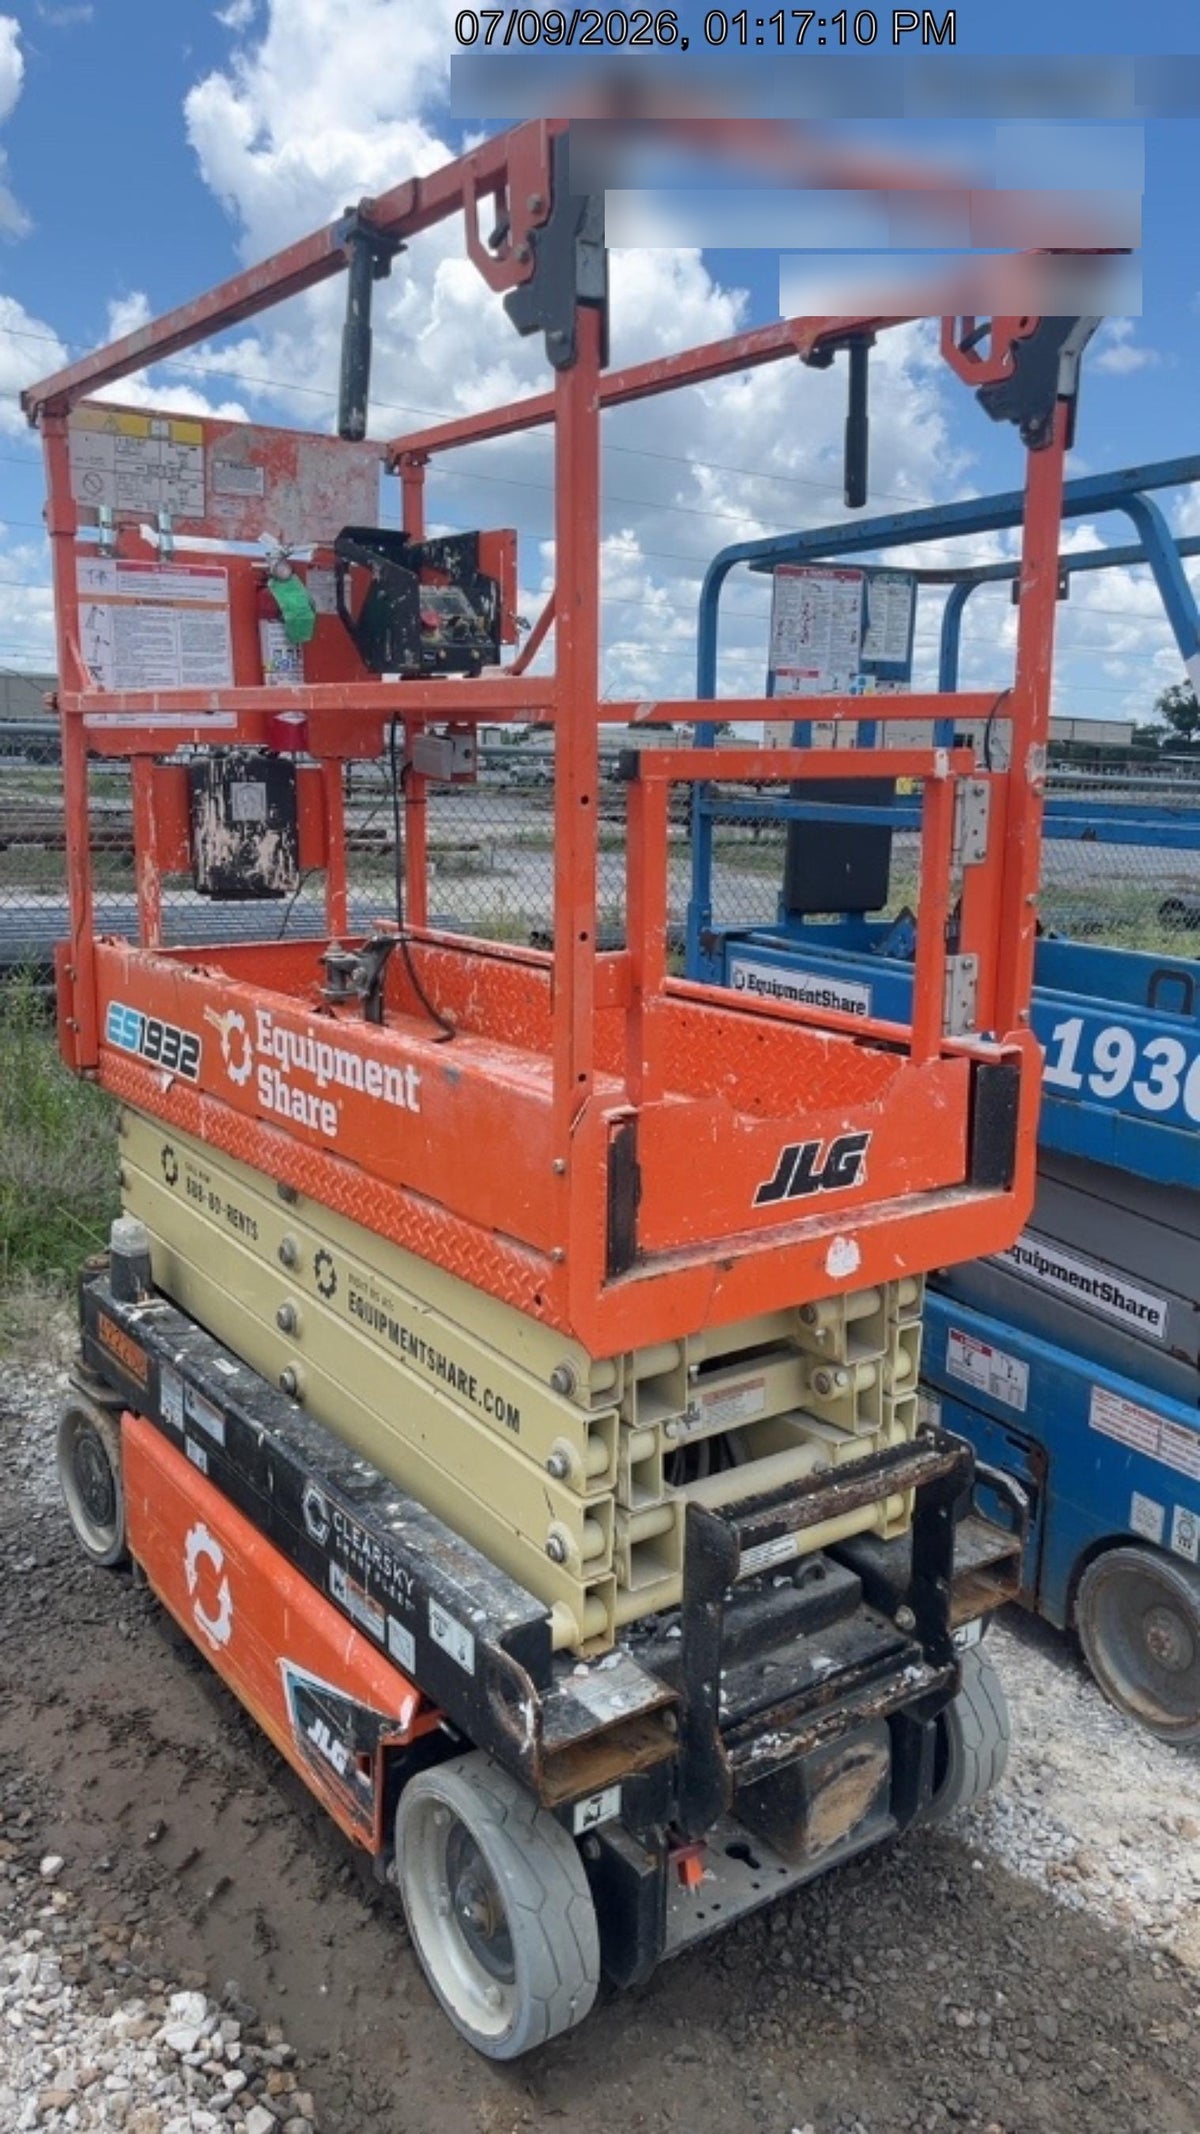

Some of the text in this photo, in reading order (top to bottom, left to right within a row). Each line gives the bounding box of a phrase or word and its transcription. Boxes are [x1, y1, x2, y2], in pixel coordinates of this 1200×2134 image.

[747, 973, 867, 1016] EquipmentShare
[107, 1003, 200, 1080] ES1932
[256, 1010, 421, 1113] Equipment
[257, 1064, 338, 1137] Share
[752, 1130, 872, 1207] JLG
[1007, 1244, 1160, 1326] quipmentShare
[348, 1289, 520, 1434] EQUIPMENTSHARE.COM
[332, 1512, 415, 1595] CLEARSKY
